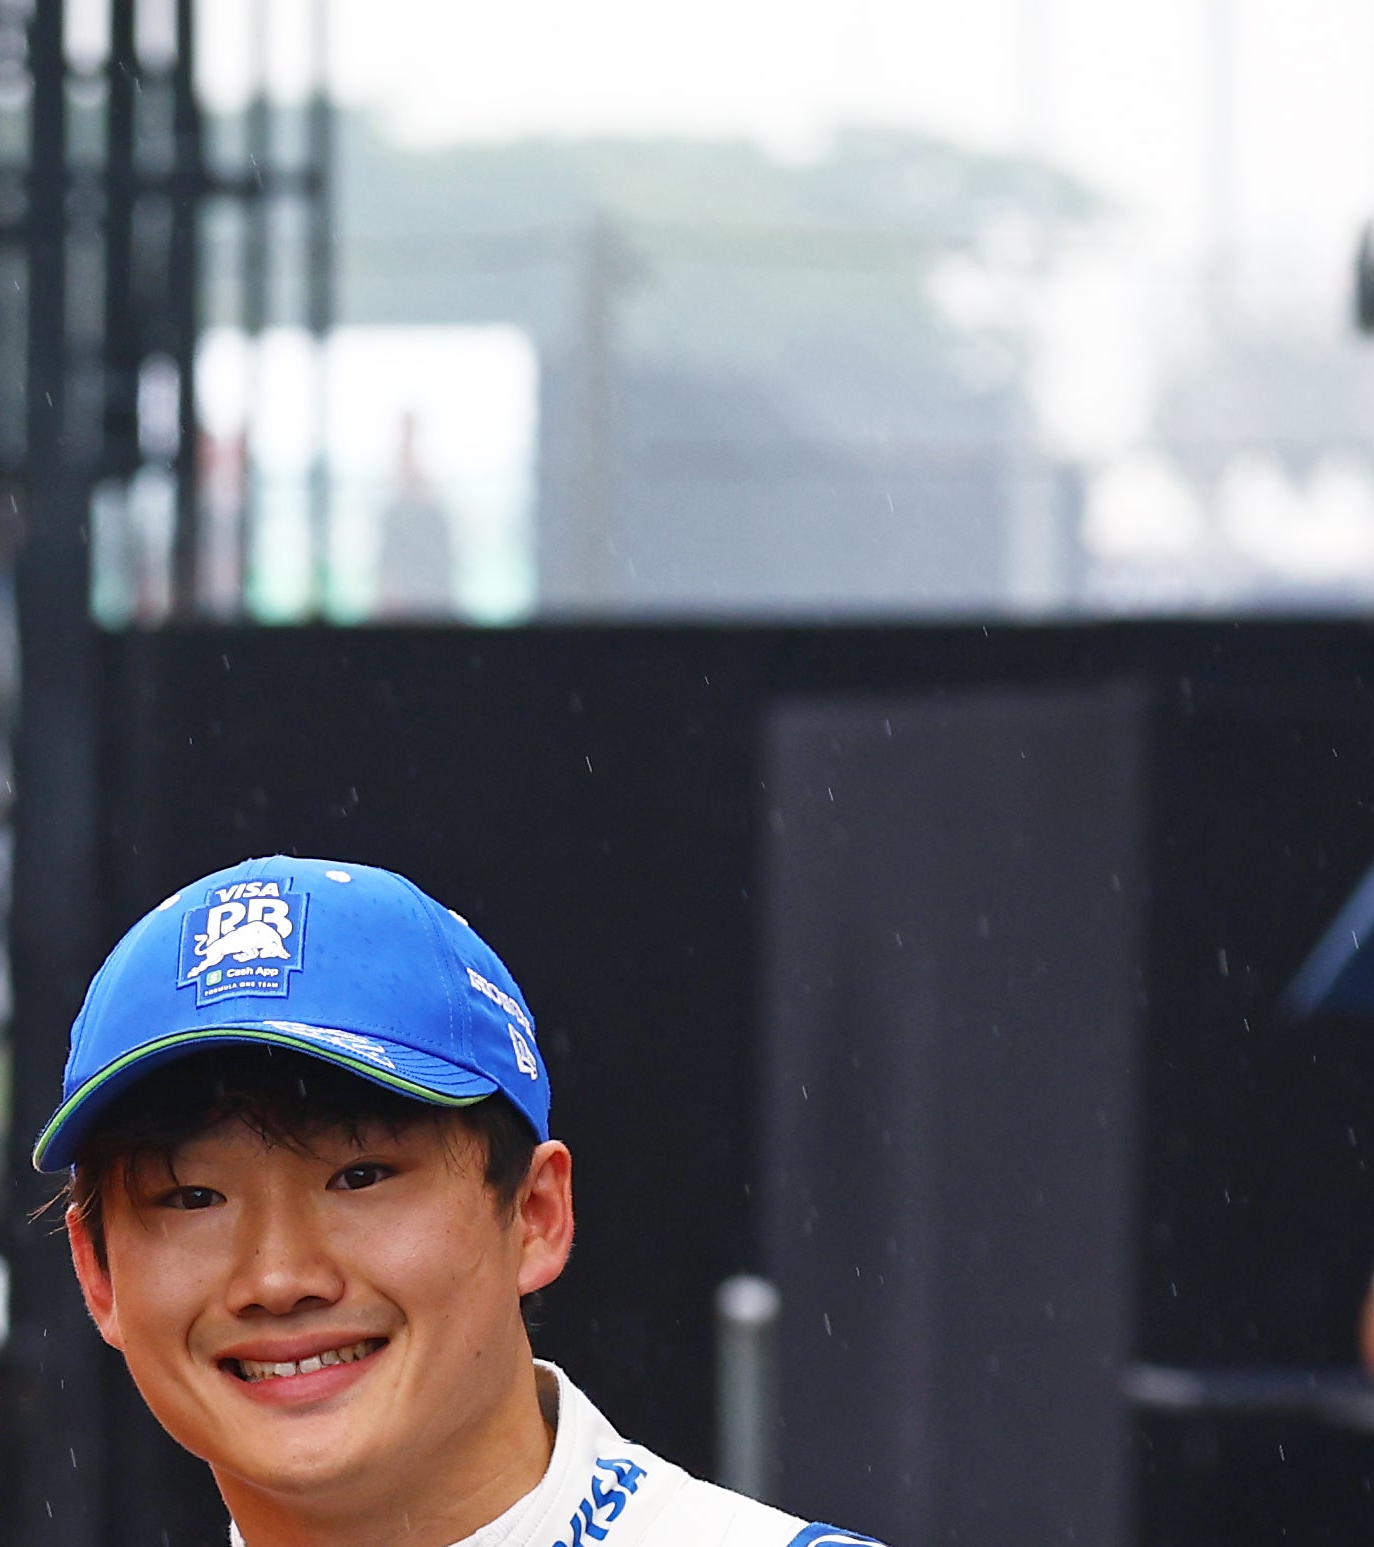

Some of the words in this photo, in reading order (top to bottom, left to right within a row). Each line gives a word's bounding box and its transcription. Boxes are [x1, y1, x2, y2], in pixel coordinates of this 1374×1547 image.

[215, 881, 280, 903] VISA
[226, 966, 255, 978] Cash
[255, 966, 279, 978] App
